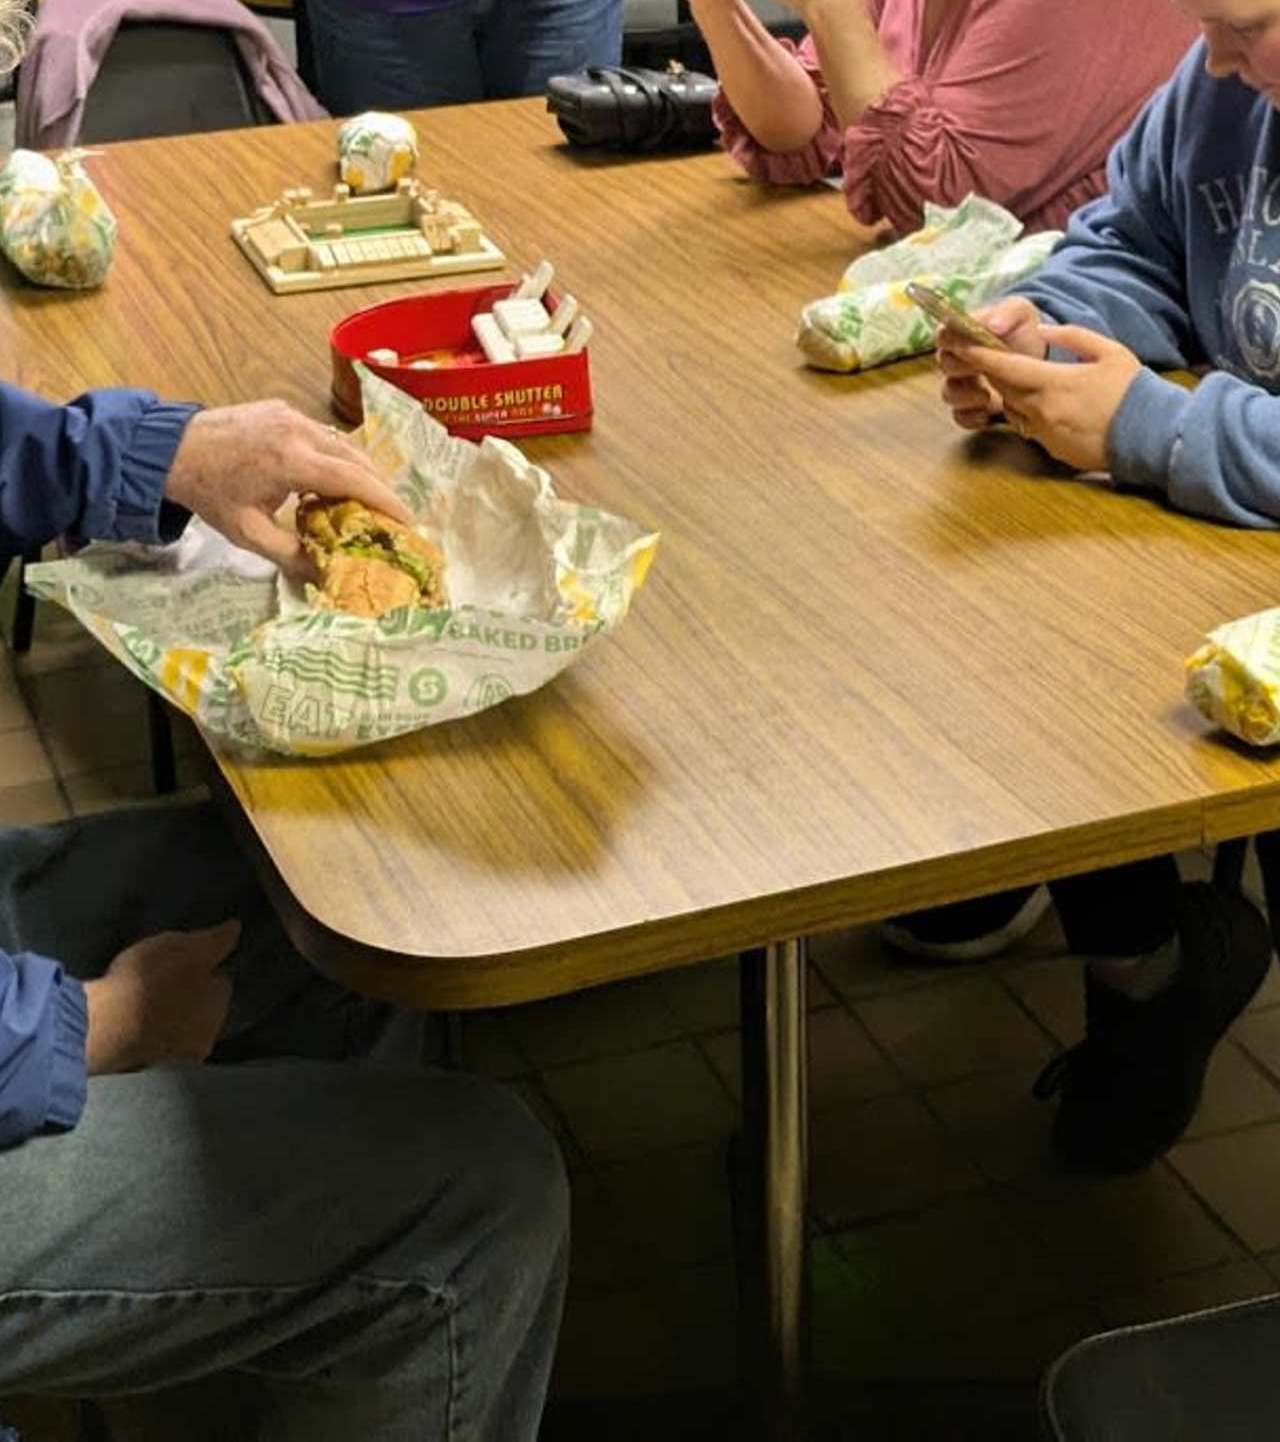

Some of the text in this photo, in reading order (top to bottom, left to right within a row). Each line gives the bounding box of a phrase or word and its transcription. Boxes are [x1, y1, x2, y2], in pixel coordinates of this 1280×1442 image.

[424, 384, 563, 411] DOUBLE SHUTTER
[448, 620, 537, 651] BAKED
